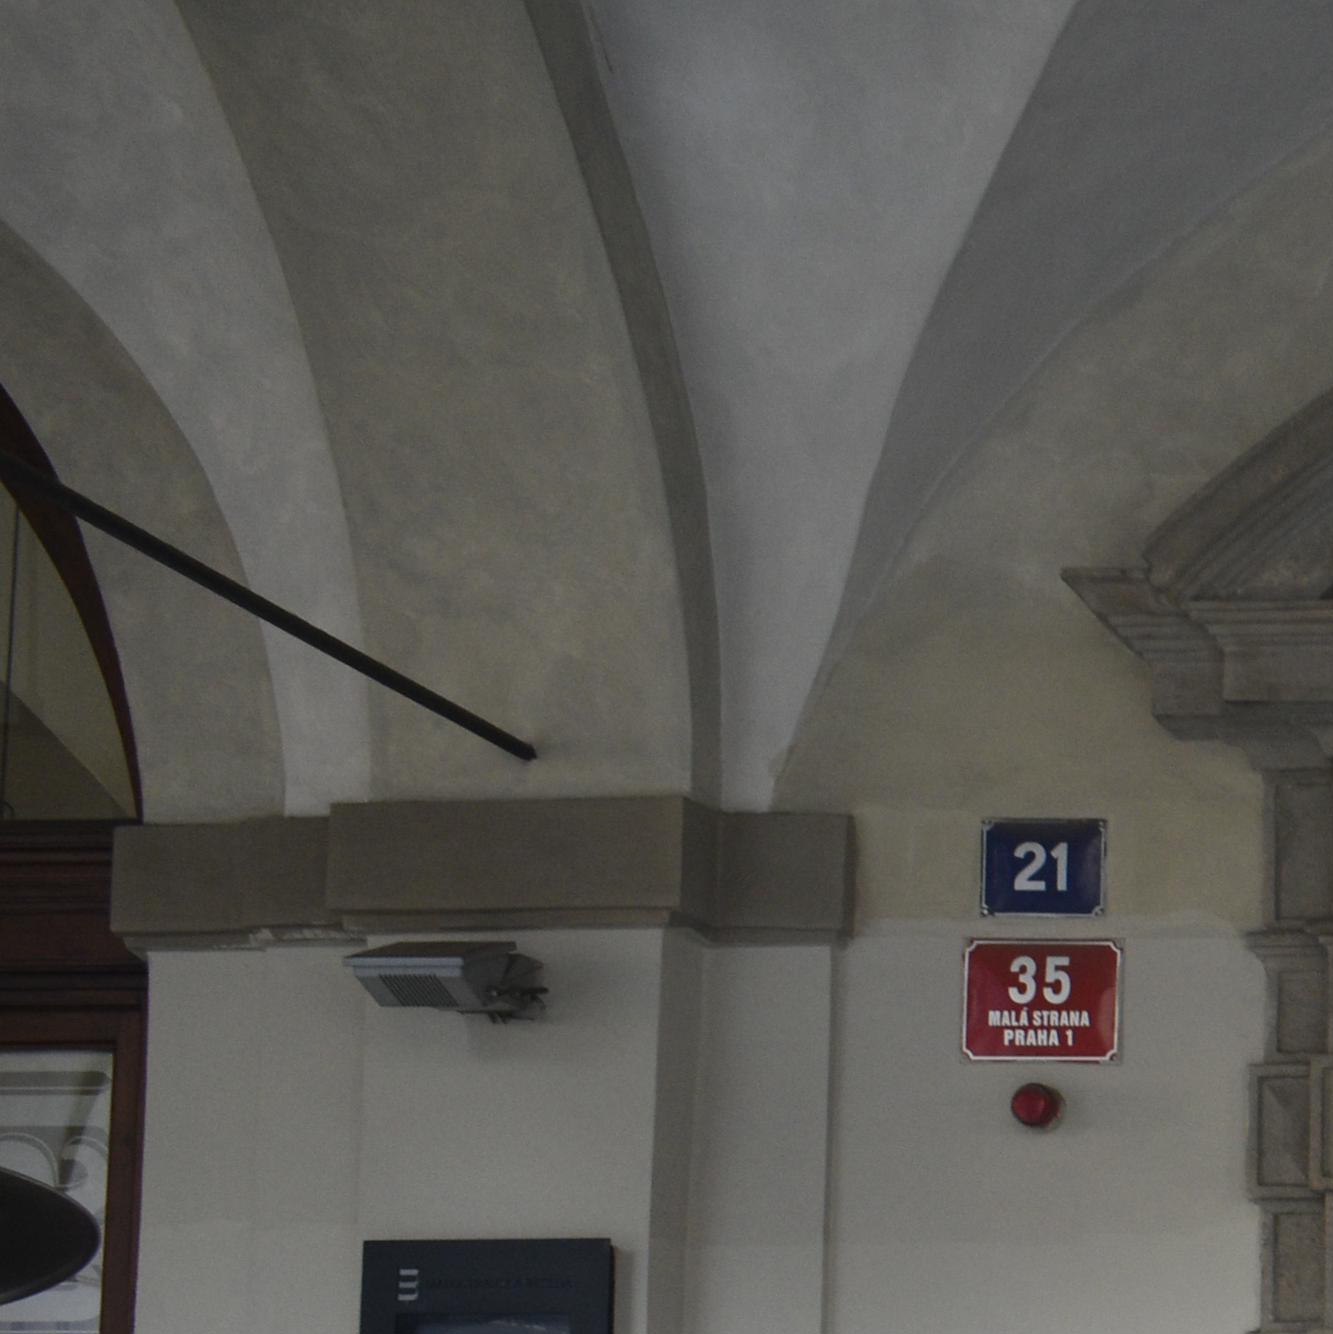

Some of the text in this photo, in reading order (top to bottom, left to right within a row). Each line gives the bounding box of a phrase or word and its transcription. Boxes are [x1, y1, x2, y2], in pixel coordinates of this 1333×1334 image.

[1013, 841, 1069, 892] 21
[1008, 955, 1071, 1005] 35
[988, 1006, 1091, 1027] MALÁ STRANA
[1003, 1029, 1074, 1047] PRAHA 1
